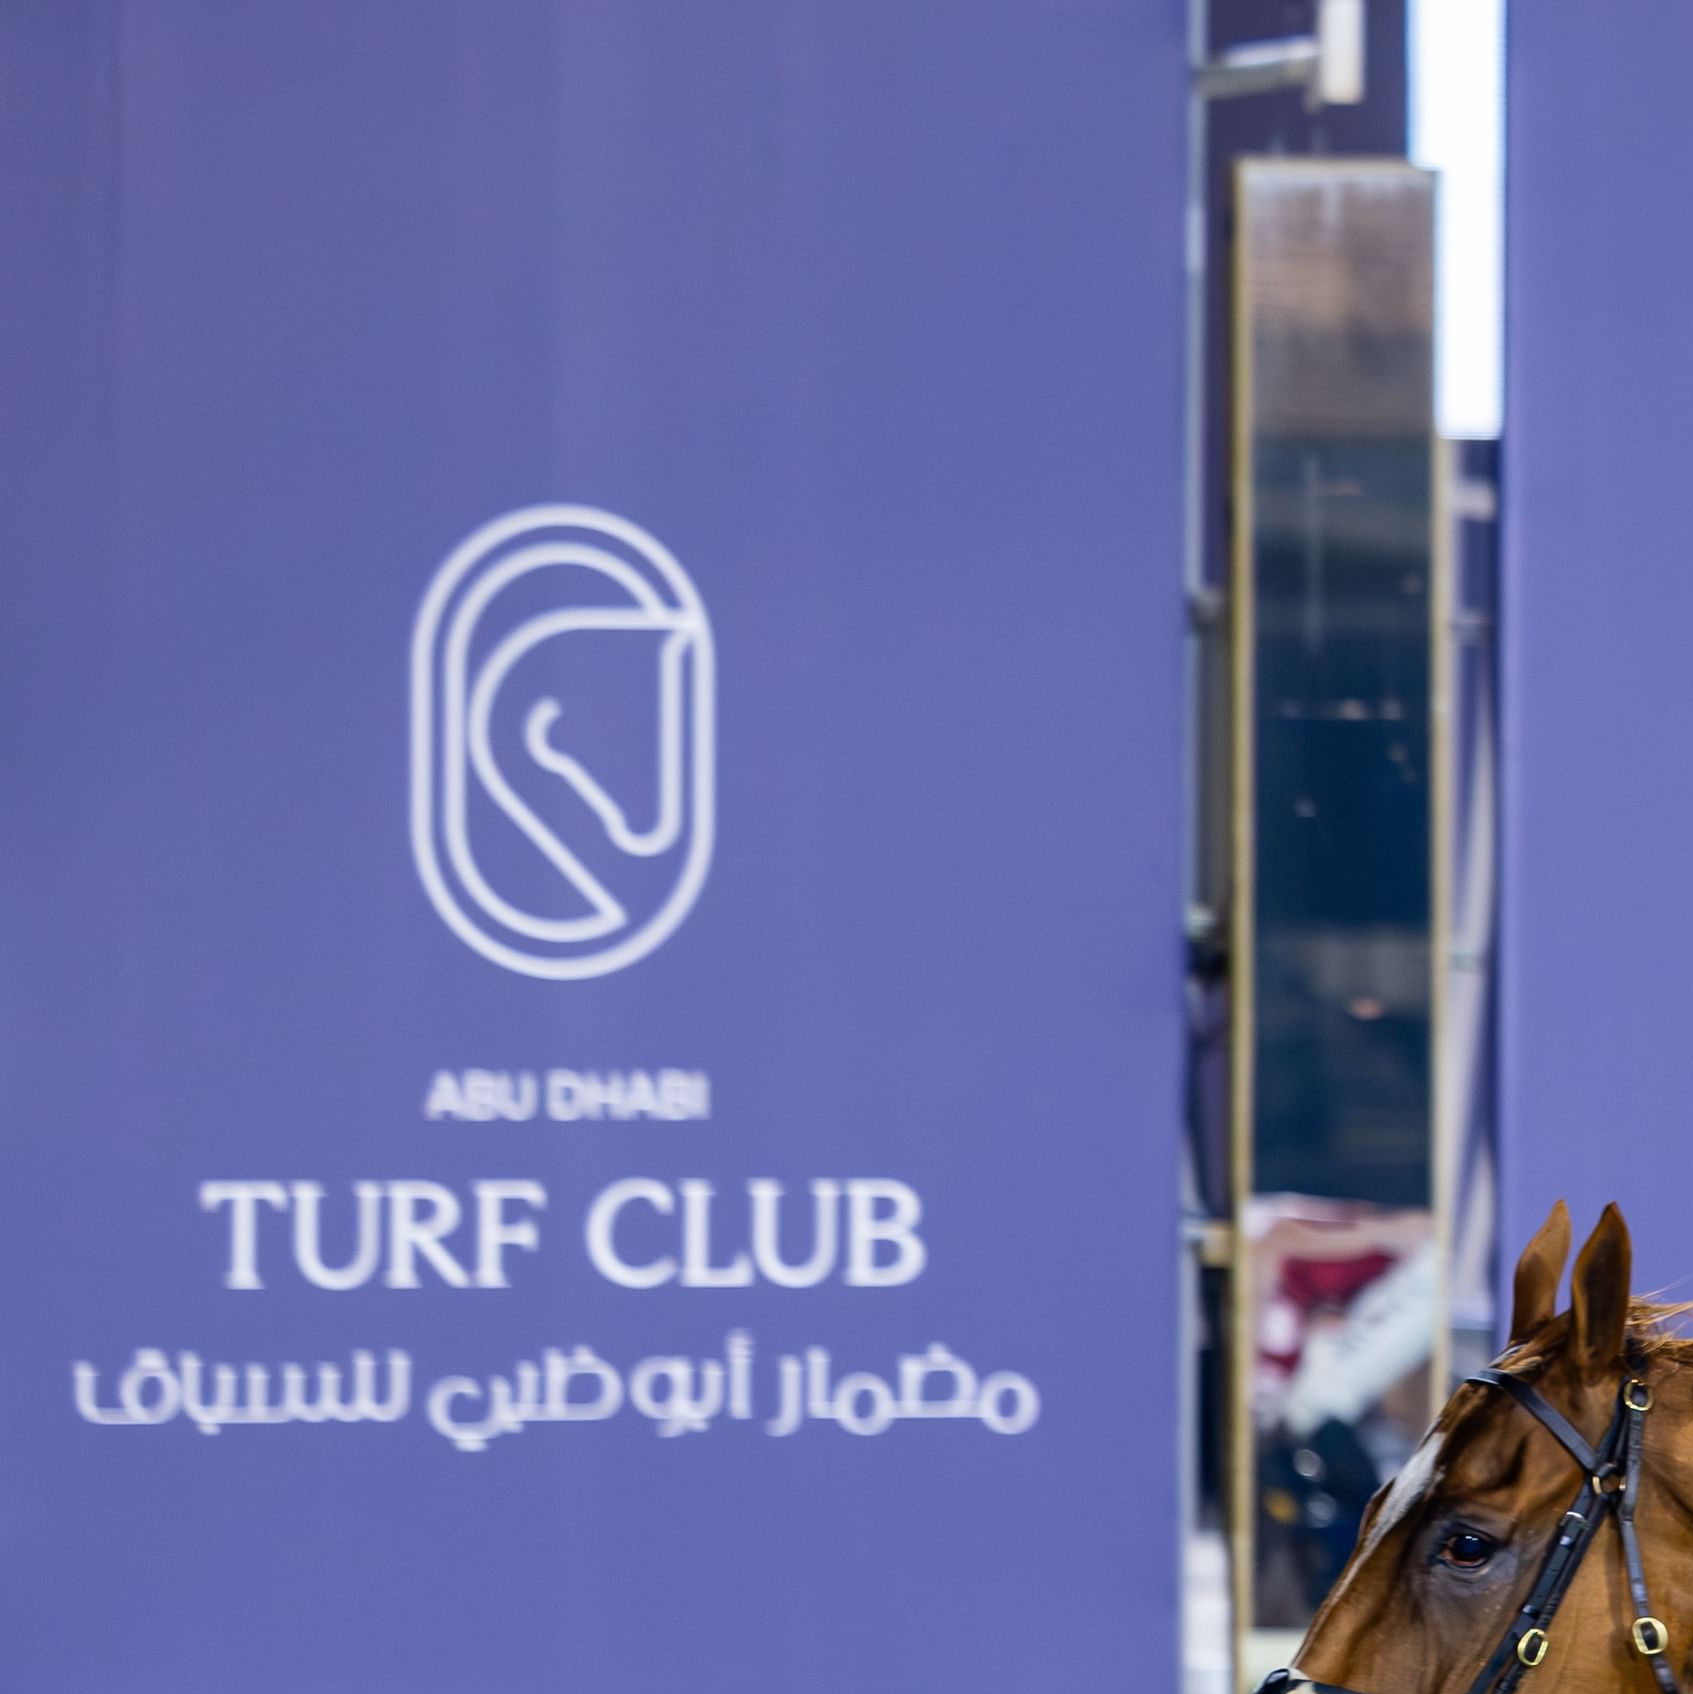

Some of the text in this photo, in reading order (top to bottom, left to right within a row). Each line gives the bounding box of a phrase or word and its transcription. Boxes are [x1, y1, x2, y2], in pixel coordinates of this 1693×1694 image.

[425, 1068, 711, 1121] ABU DHABI
[200, 1177, 927, 1290] TURF CLUB
[73, 1347, 412, 1436] للسباق
[765, 1342, 1041, 1437] مضمار
